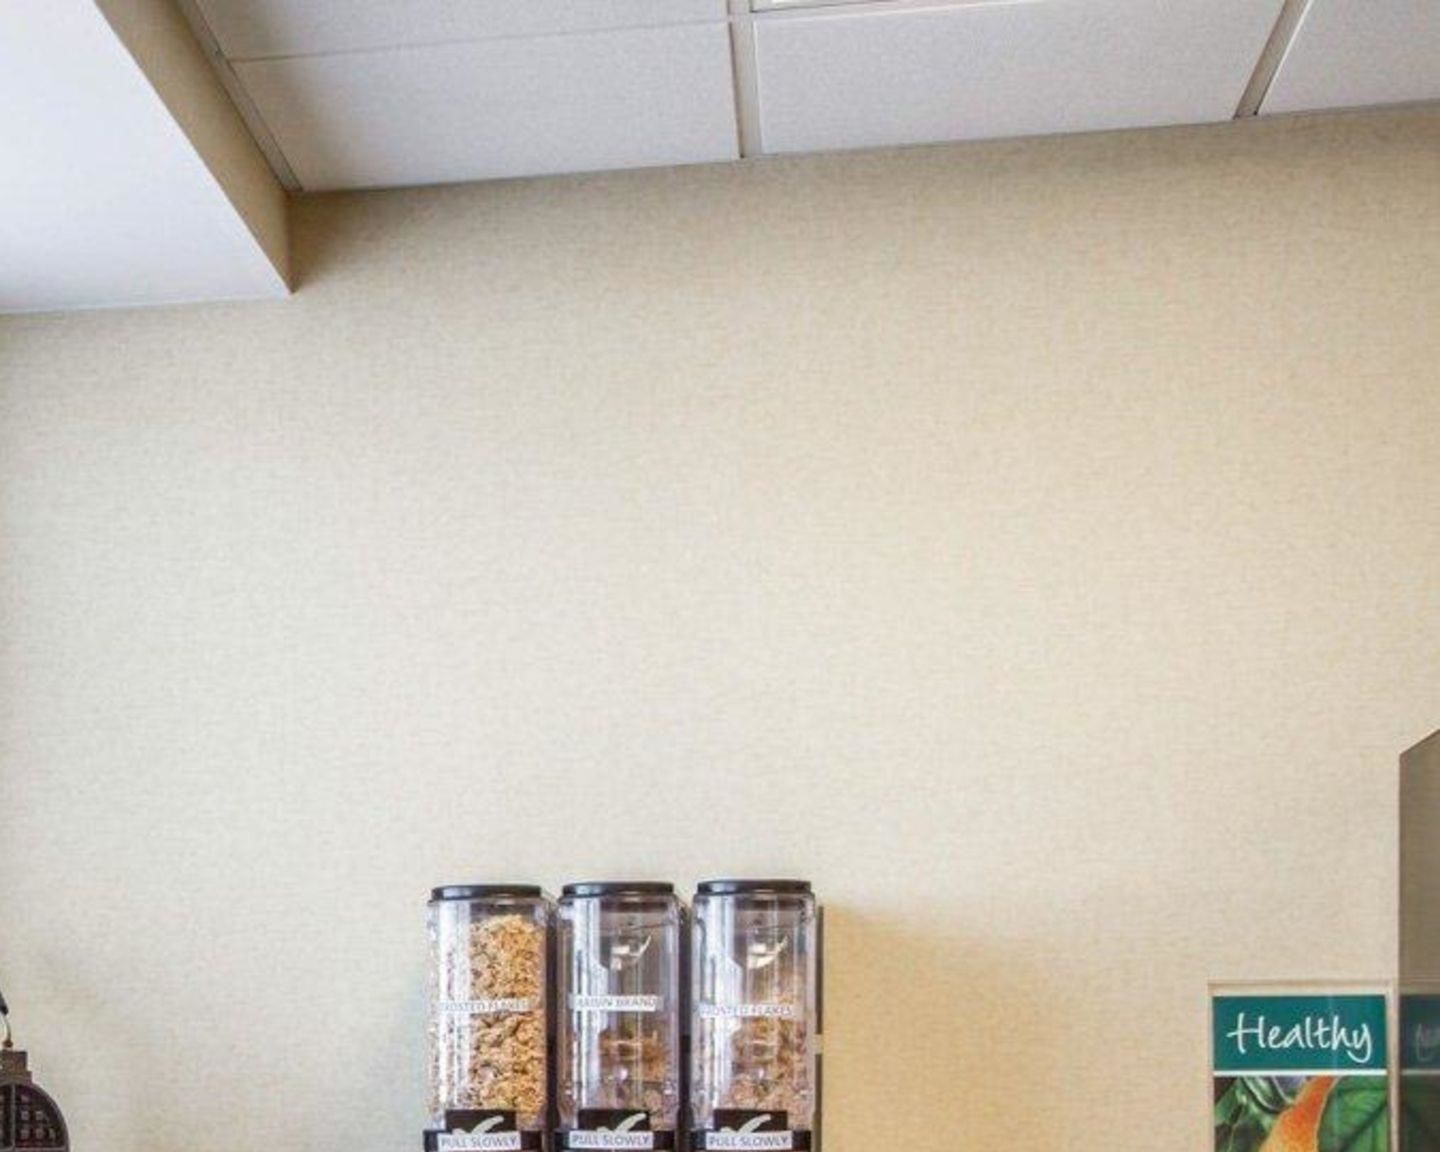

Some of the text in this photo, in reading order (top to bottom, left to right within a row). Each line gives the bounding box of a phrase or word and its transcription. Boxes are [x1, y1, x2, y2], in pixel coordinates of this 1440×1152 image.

[1225, 1011, 1372, 1064] Healthy
[440, 1134, 517, 1149] PULL SLOWLY
[571, 1133, 650, 1146] PULL SLOWLY
[708, 1134, 787, 1147] PULL SLOWLY
